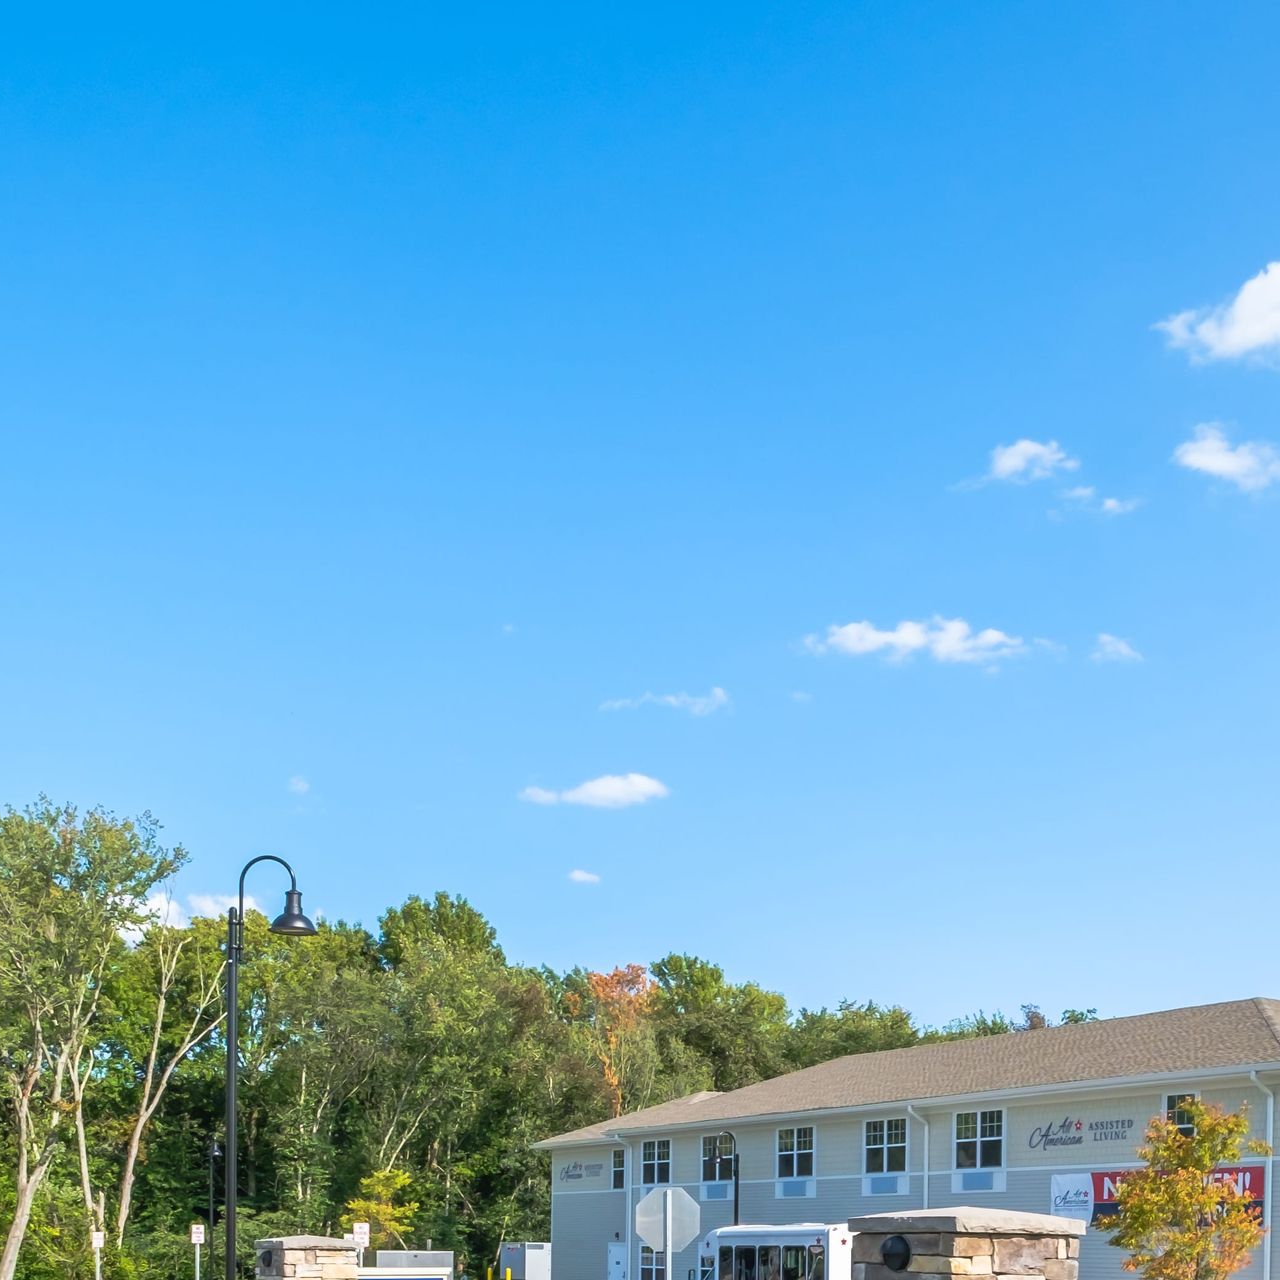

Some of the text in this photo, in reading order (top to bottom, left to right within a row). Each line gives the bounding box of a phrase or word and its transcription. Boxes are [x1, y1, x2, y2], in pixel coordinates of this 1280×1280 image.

[1052, 1117, 1074, 1135] All
[1088, 1120, 1134, 1131] ASSISTED
[1029, 1122, 1083, 1151] American
[1093, 1130, 1127, 1141] LIVING
